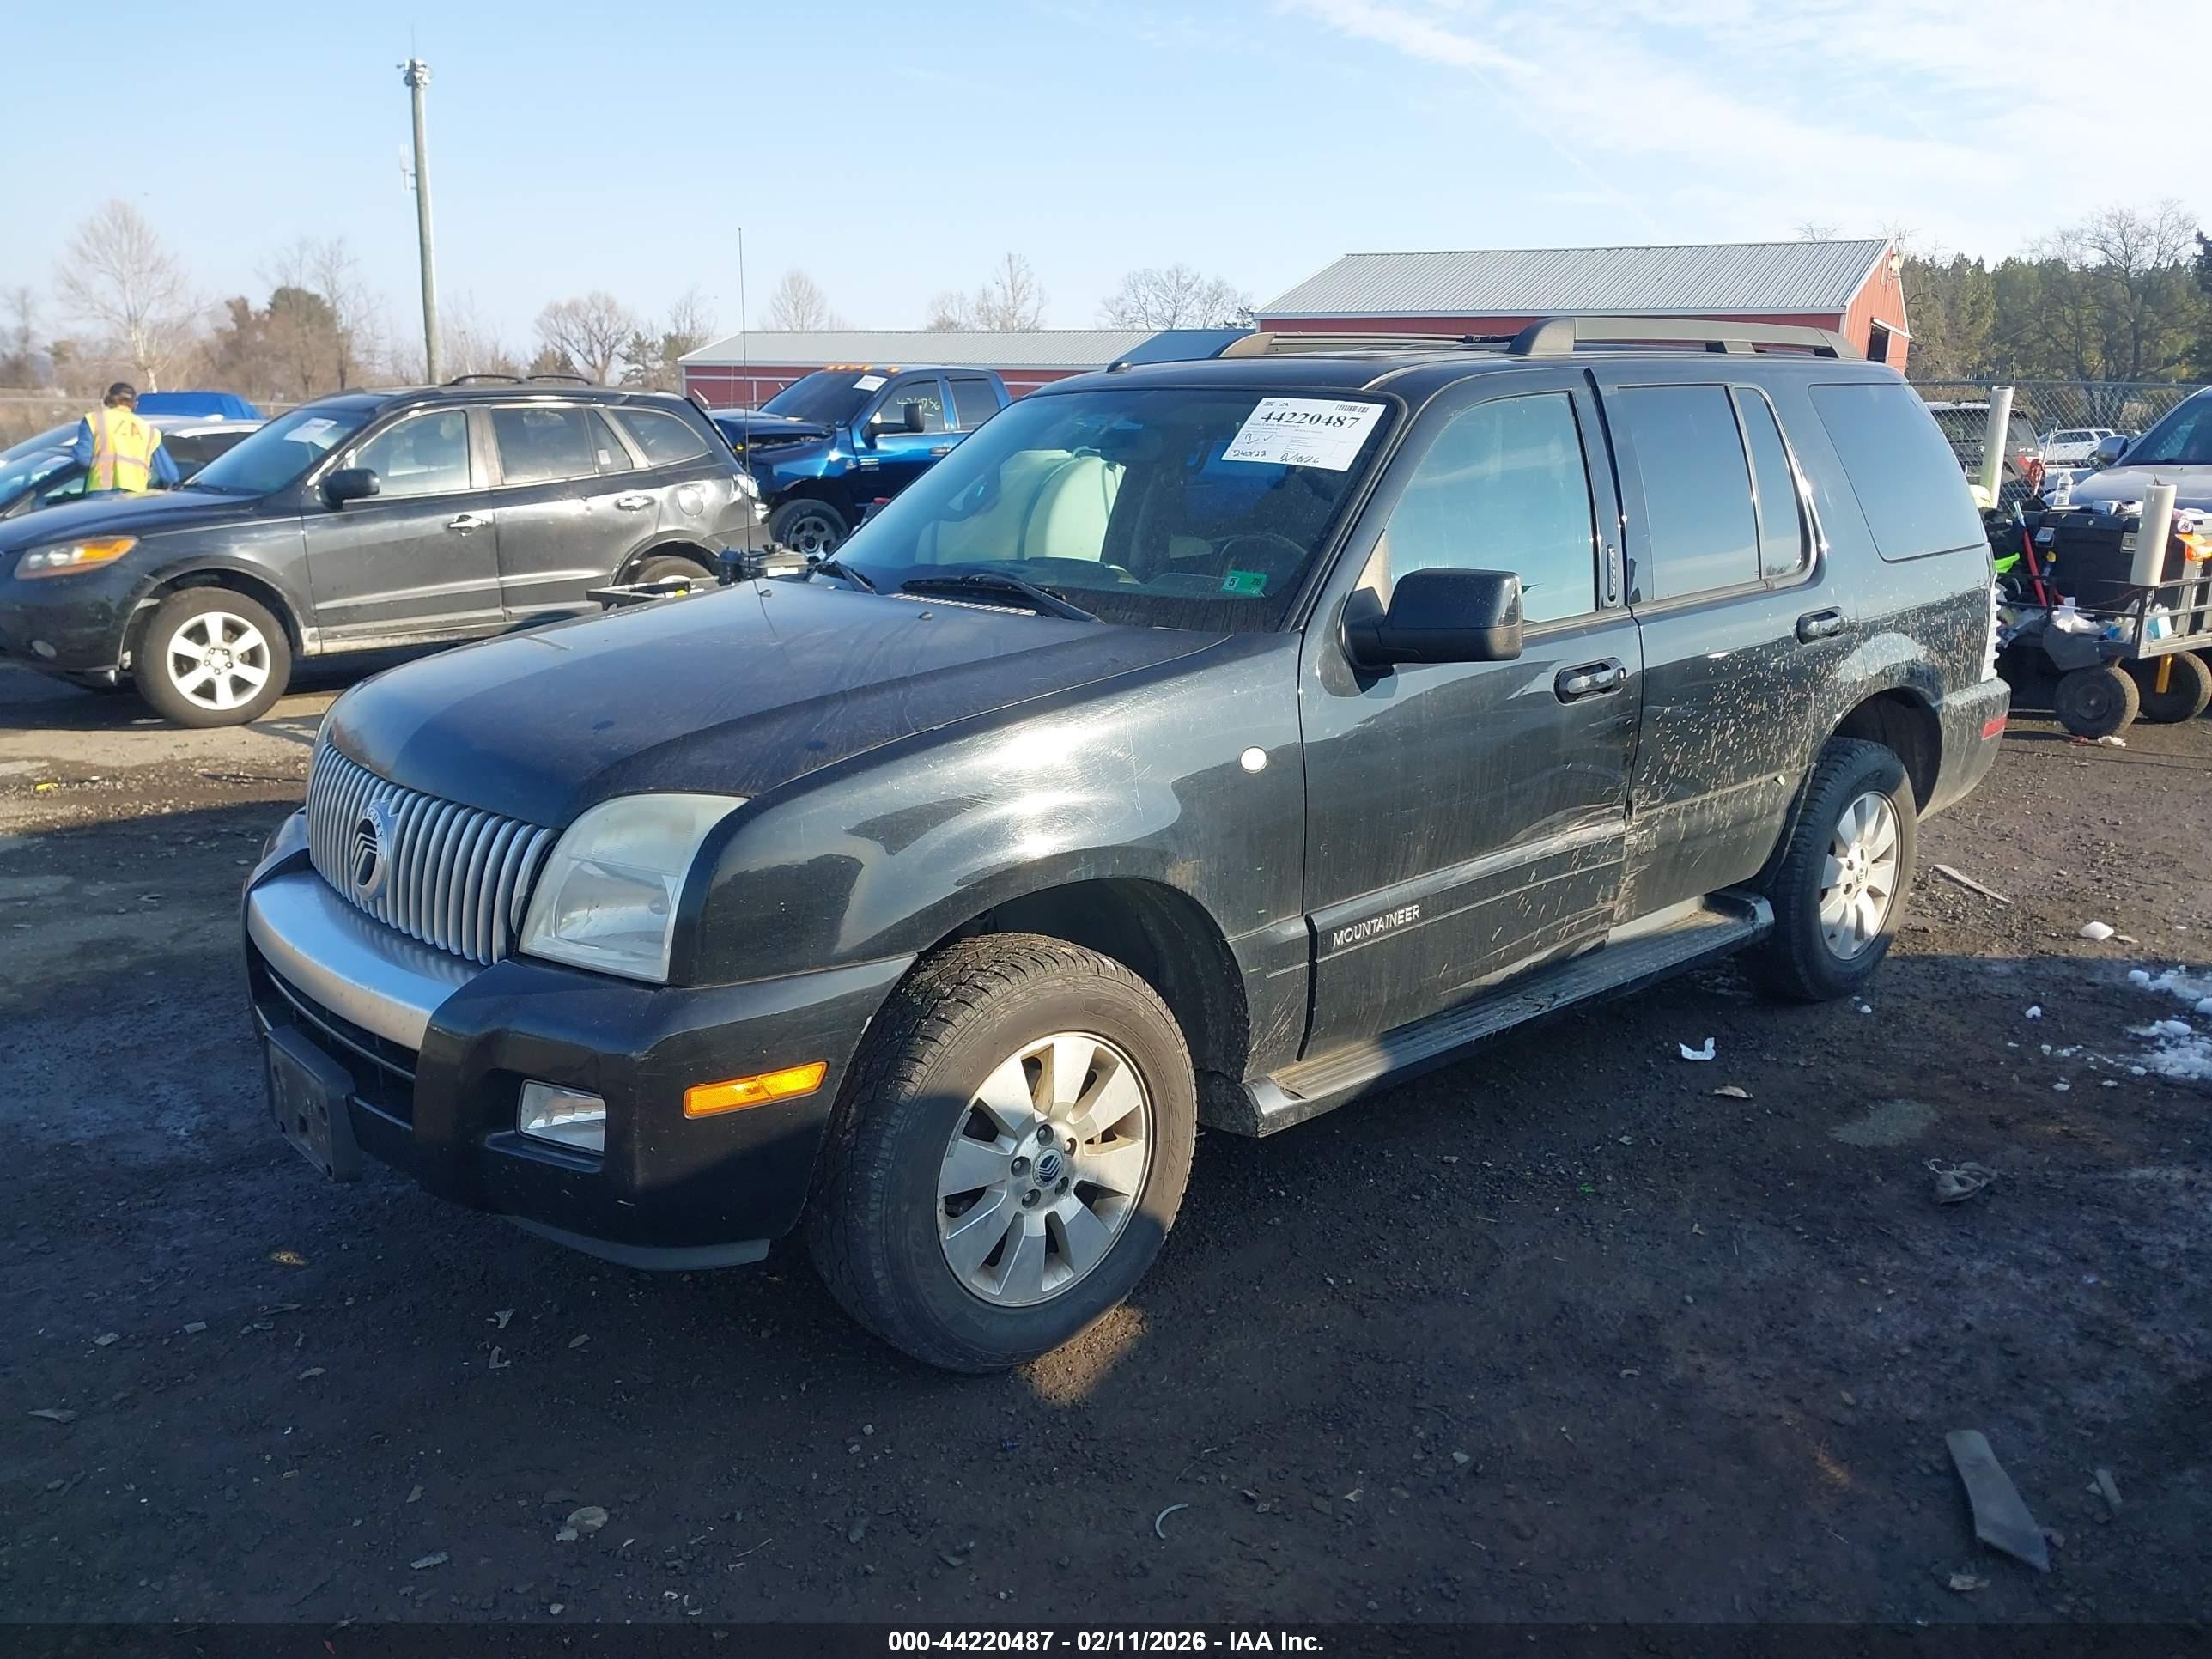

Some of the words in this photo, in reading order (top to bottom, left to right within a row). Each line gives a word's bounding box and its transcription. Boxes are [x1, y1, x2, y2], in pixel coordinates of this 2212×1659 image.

[1261, 410, 1362, 429] 44220487
[1229, 577, 1237, 586] 5
[1332, 904, 1420, 947] MOUNTAINEER
